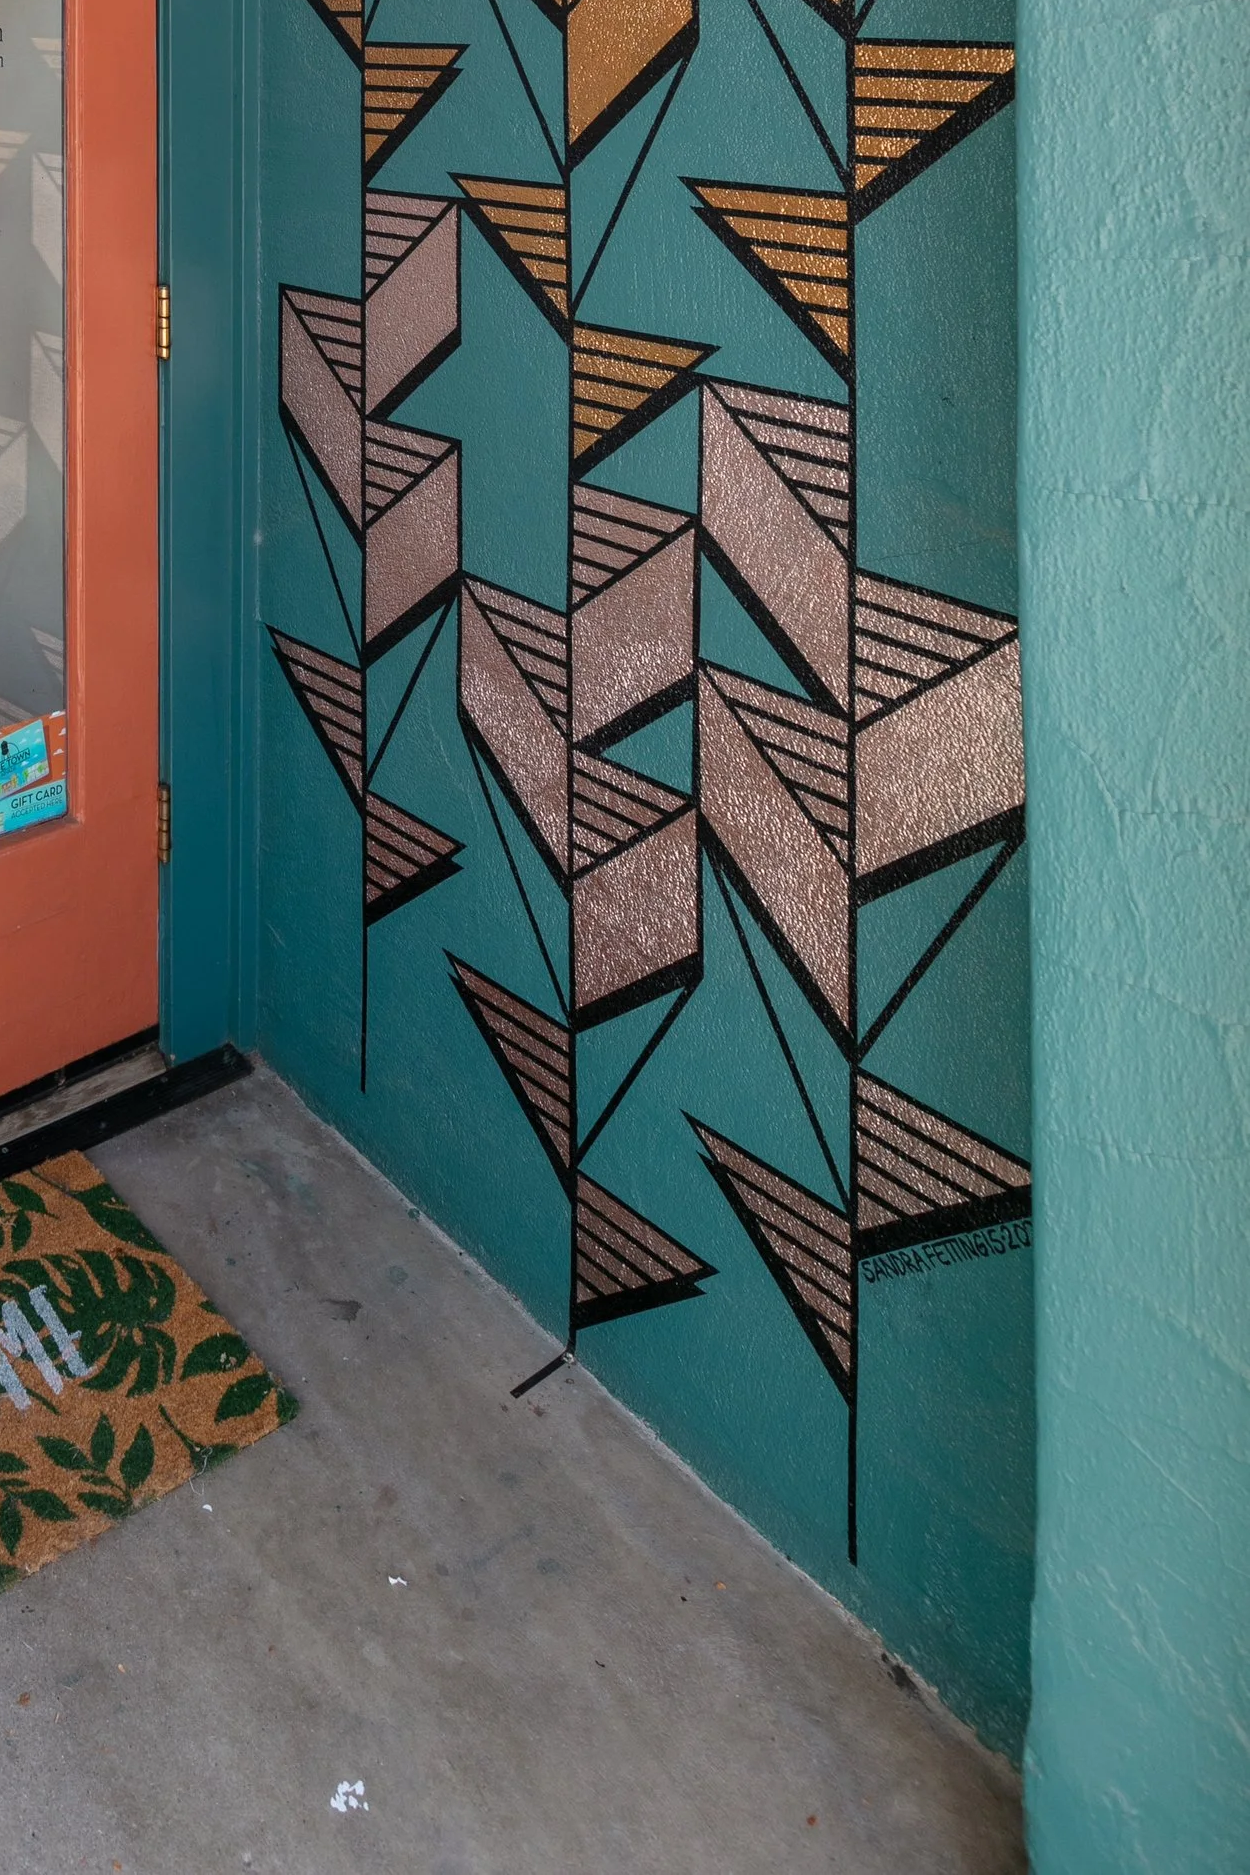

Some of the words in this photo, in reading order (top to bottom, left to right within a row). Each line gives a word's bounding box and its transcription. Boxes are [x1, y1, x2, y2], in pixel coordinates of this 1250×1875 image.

[6, 750, 30, 767] TOWN
[11, 793, 33, 809] GIFT
[35, 784, 63, 801] CARD
[11, 803, 46, 819] ACCEPTED
[861, 1249, 931, 1283] SANDRA
